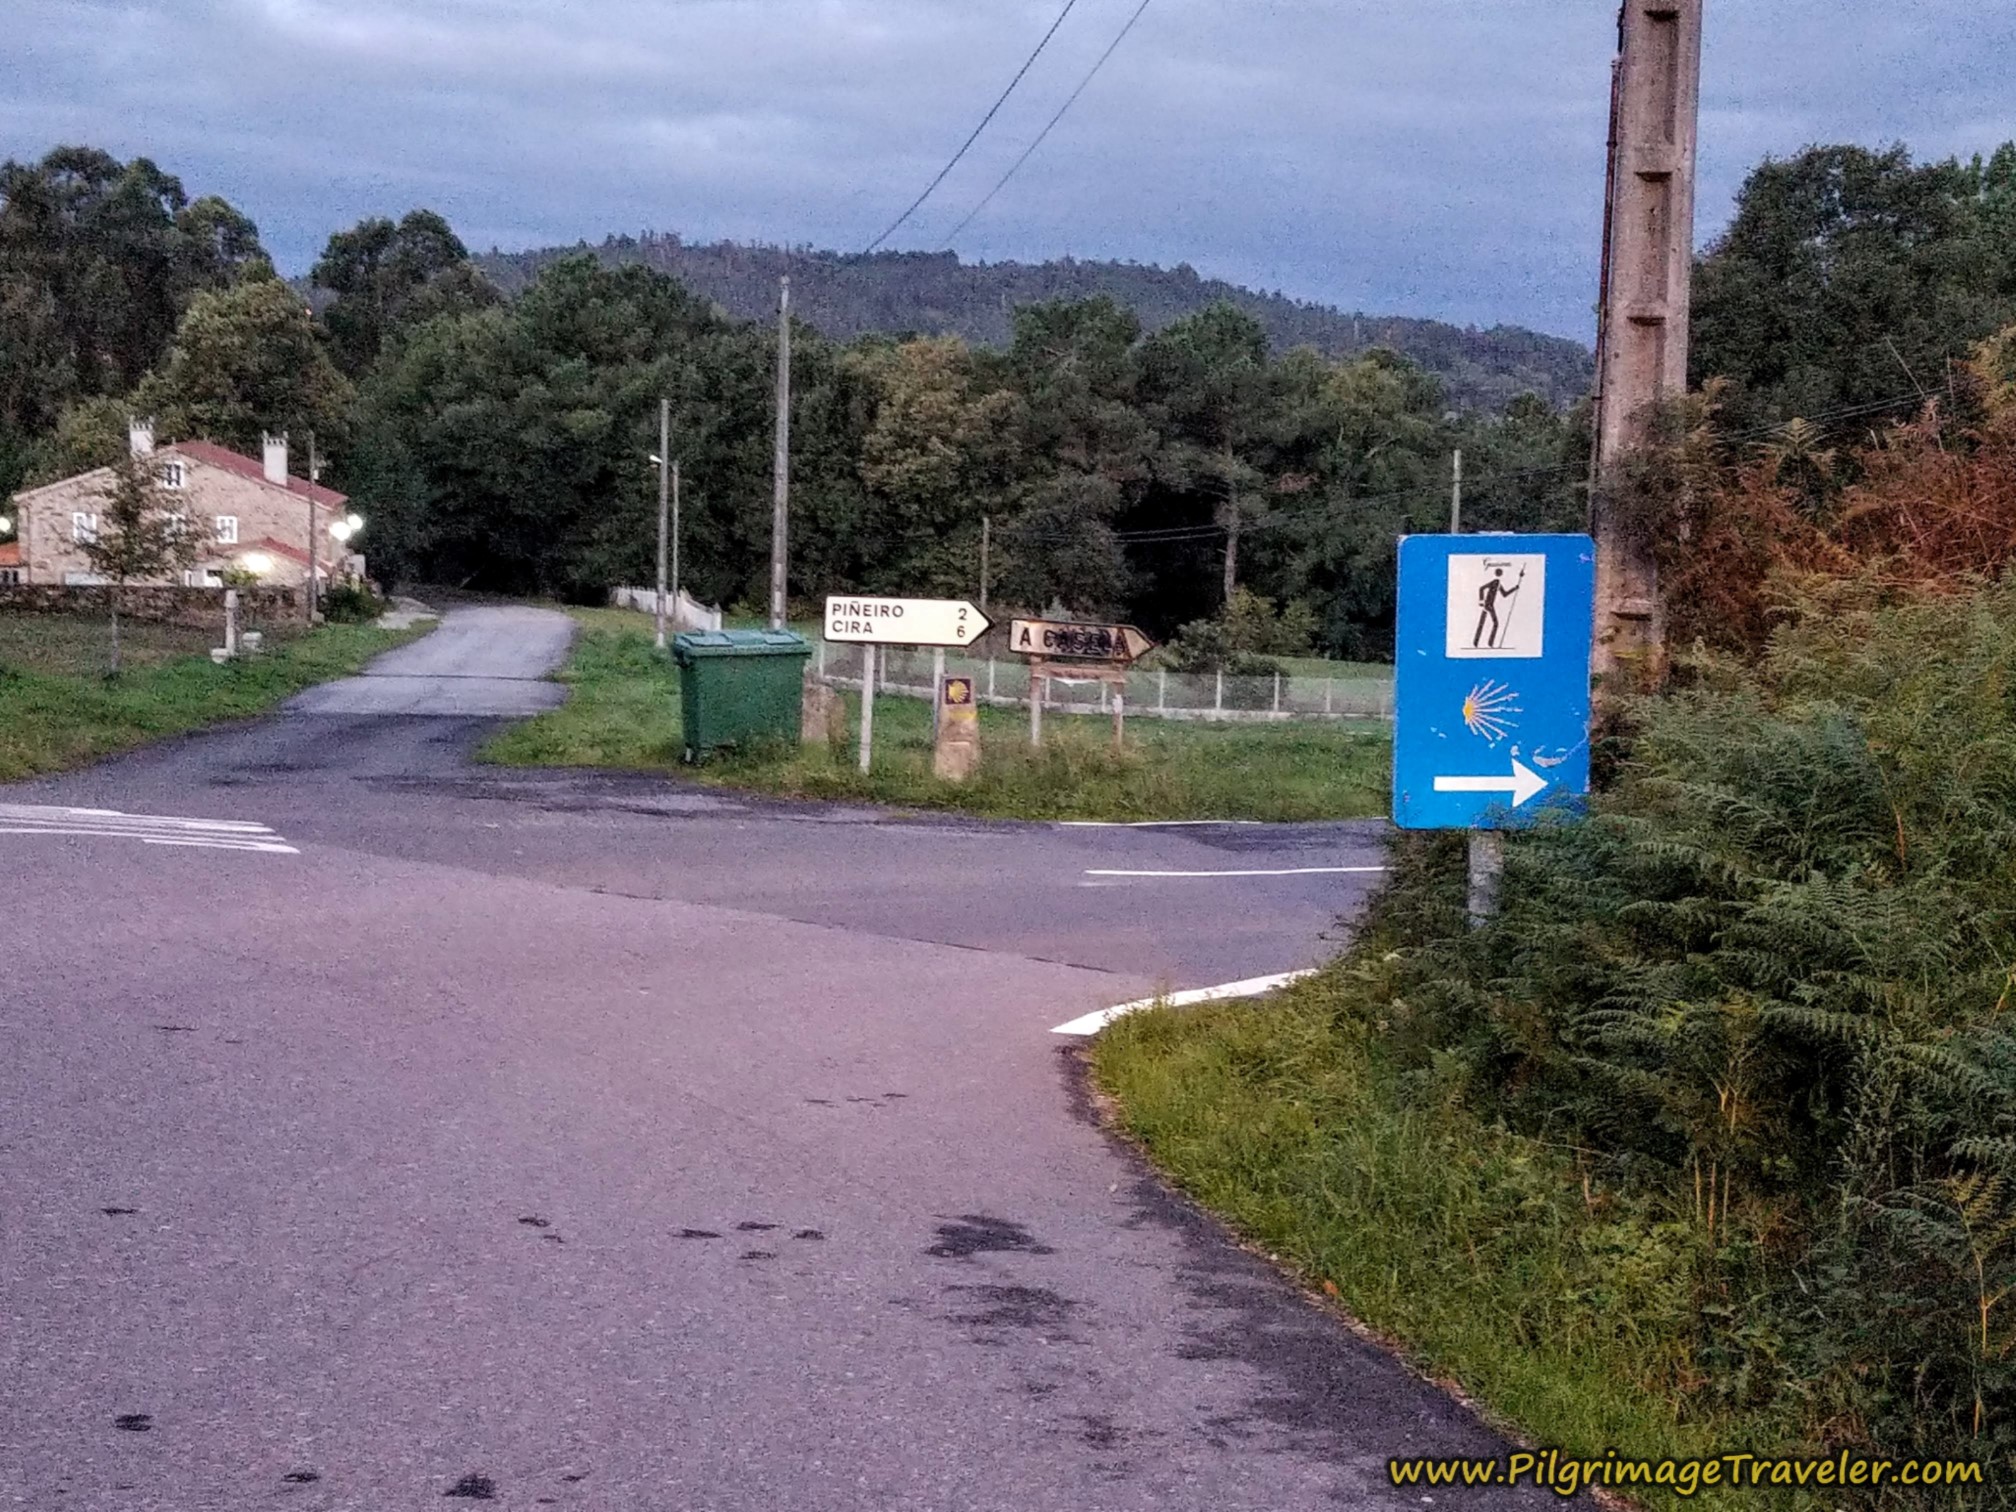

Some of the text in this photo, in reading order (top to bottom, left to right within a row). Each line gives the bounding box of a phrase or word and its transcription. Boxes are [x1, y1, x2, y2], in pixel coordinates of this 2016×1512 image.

[832, 601, 968, 621] PIÑEIRO 2
[832, 620, 966, 638] CIRA 6
